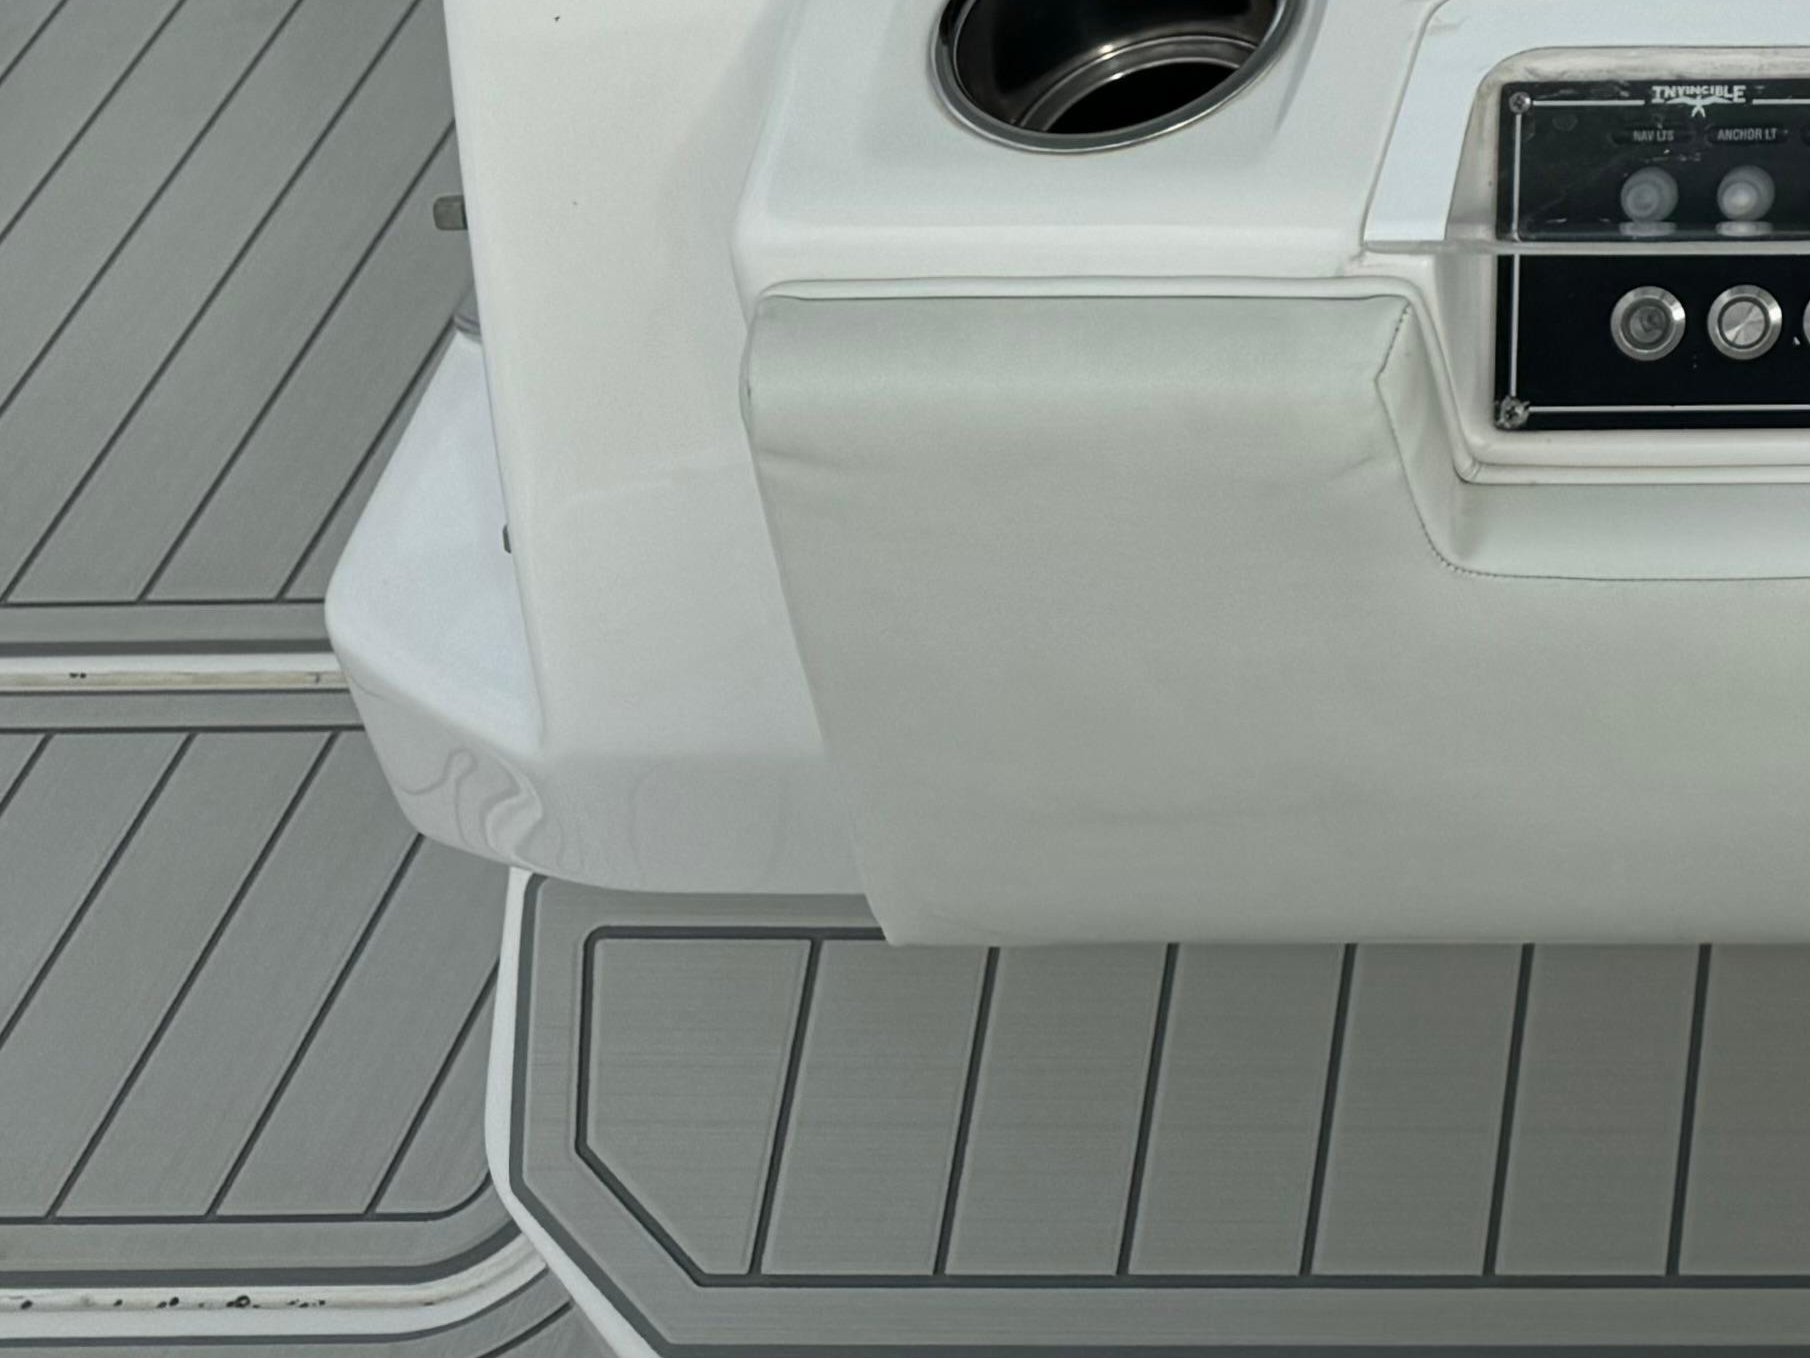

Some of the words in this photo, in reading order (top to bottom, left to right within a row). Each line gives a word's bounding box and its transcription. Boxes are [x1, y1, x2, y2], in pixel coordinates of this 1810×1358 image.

[1650, 84, 1747, 105] INVINCIBLE
[1717, 128, 1762, 142] ANCHOR
[1764, 127, 1778, 141] LT
